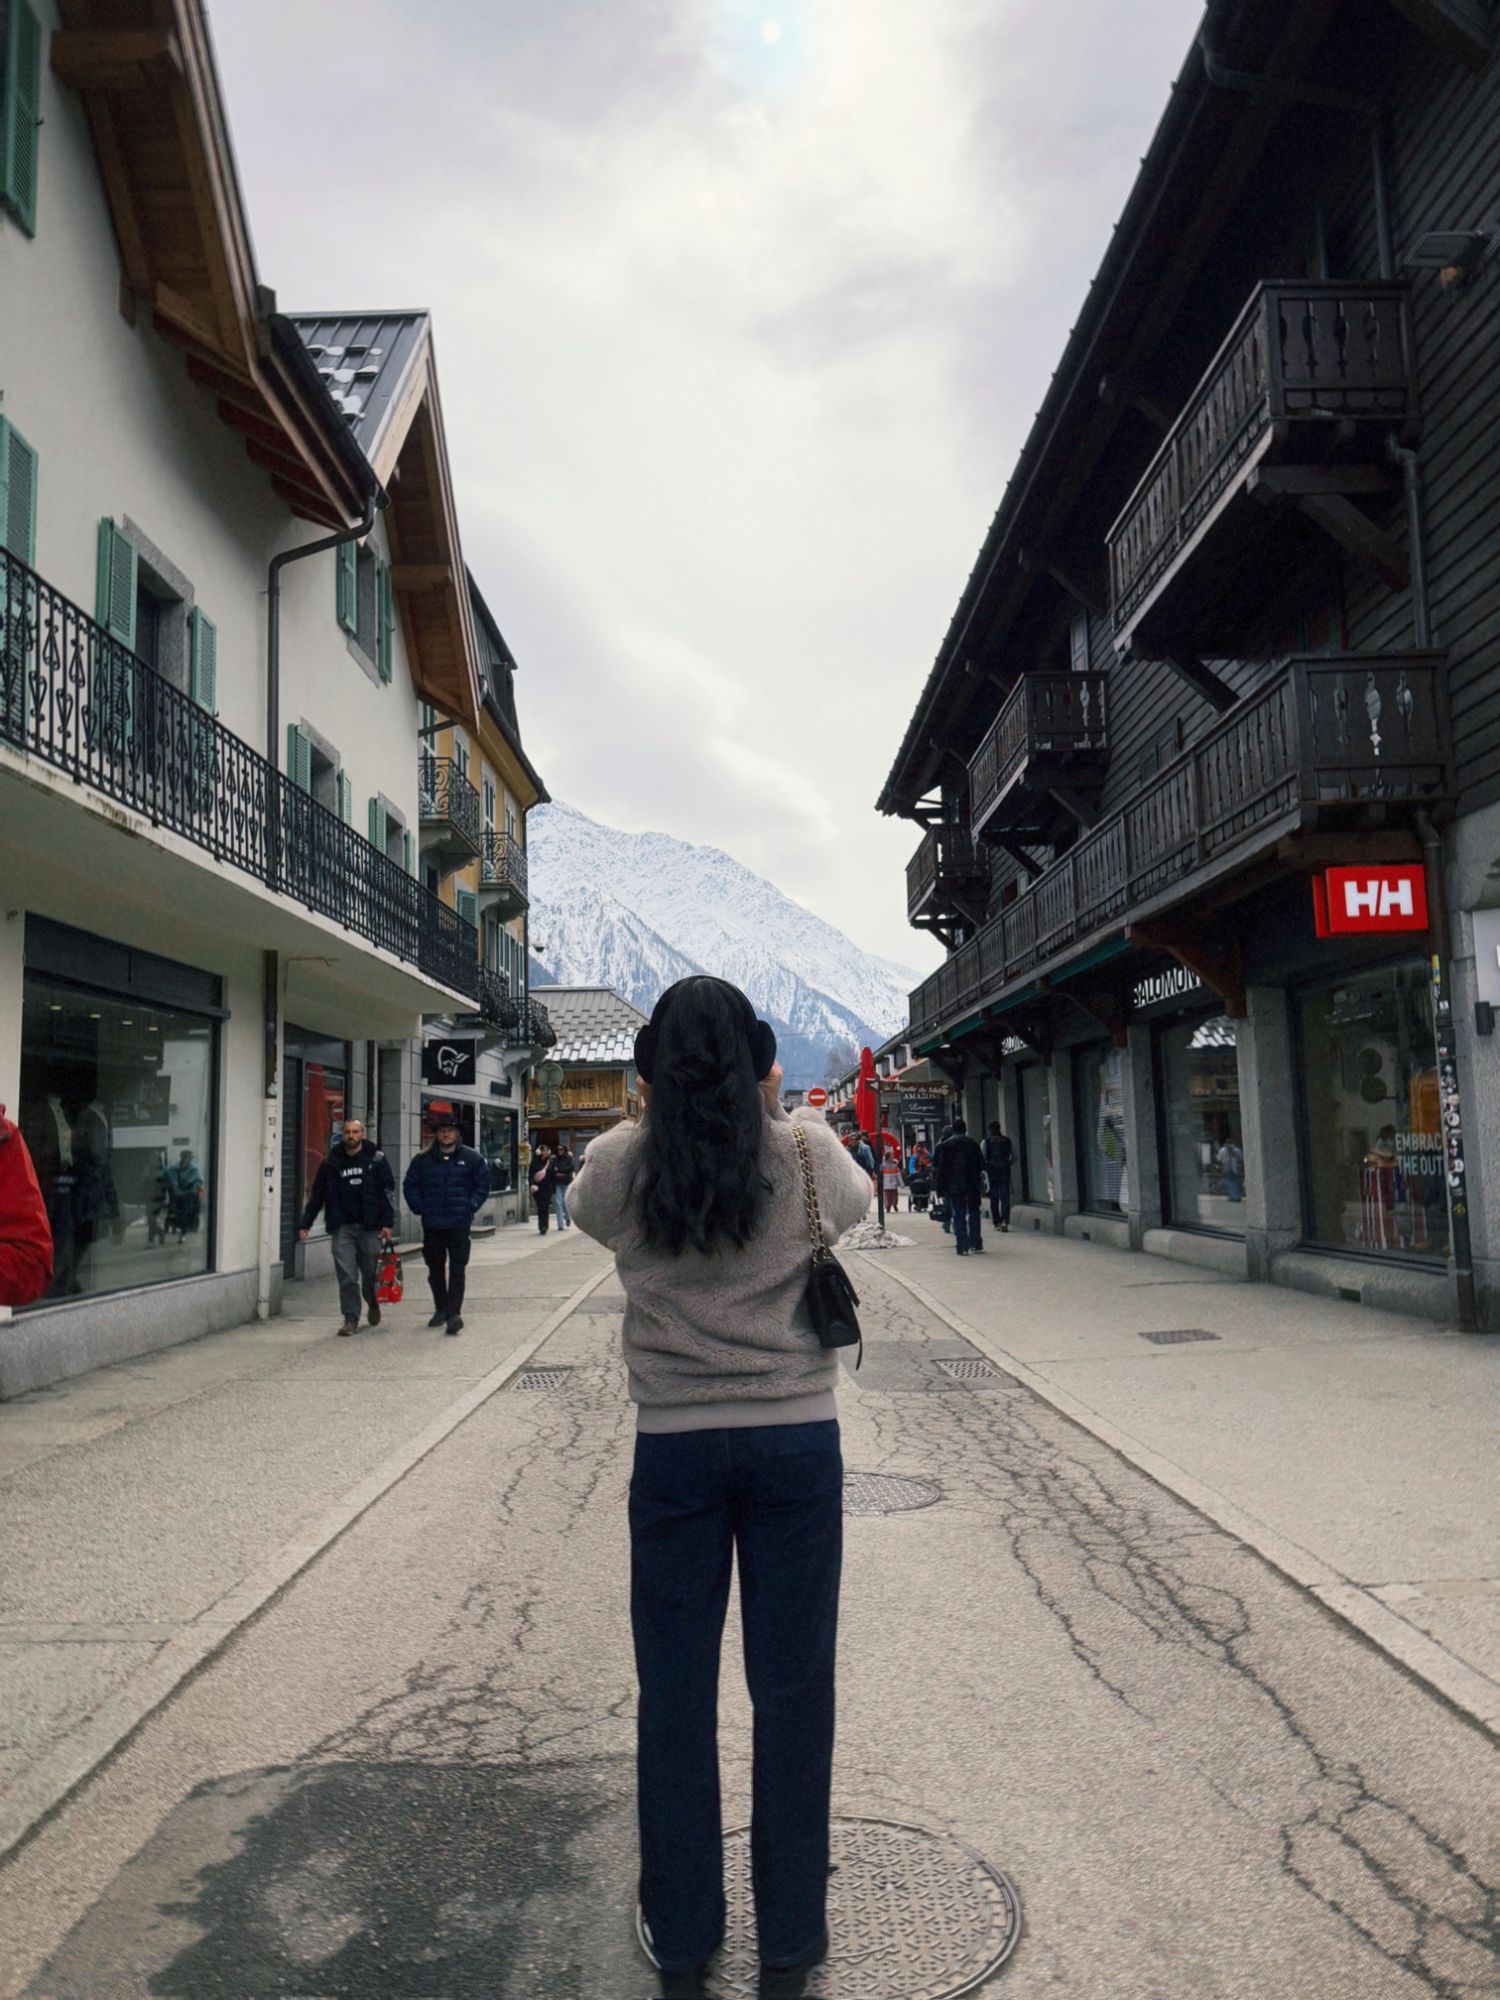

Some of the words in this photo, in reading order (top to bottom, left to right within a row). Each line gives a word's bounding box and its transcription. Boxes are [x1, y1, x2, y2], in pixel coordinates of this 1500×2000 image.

[1344, 879, 1413, 917] HH
[1133, 965, 1202, 1008] SALOMON
[1395, 1132, 1442, 1152] EMBRAC
[1396, 1155, 1418, 1175] THE
[1420, 1154, 1442, 1176] OUT
